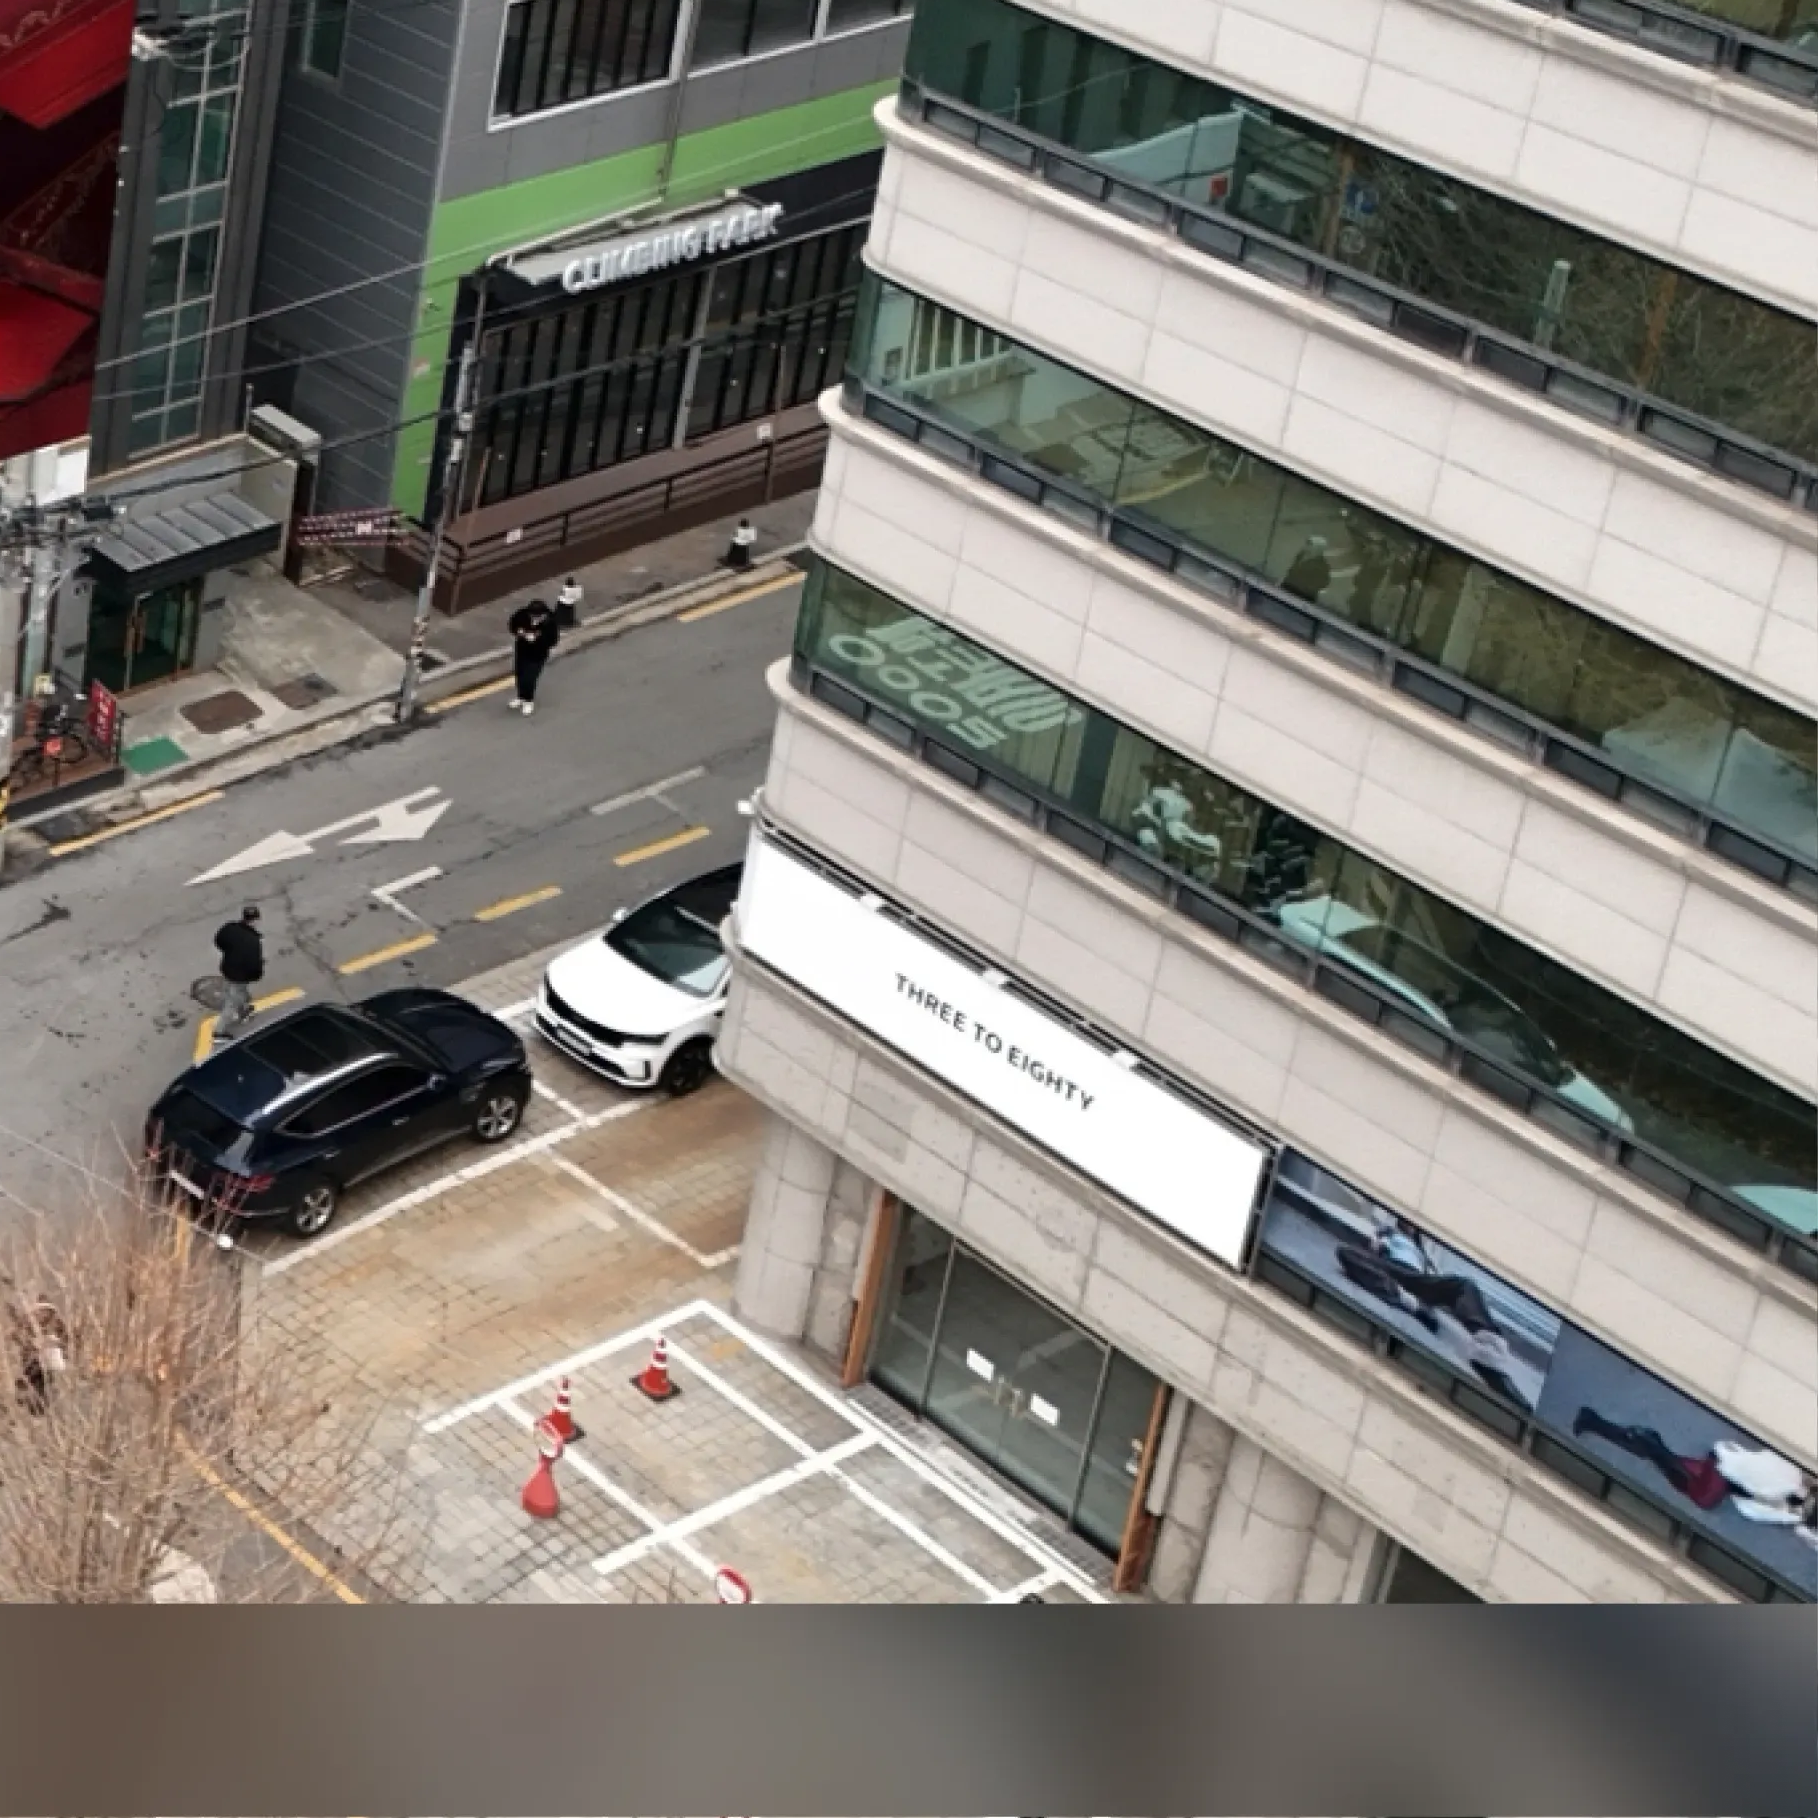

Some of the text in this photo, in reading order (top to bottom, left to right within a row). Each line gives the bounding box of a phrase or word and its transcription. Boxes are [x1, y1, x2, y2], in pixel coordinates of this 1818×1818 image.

[562, 202, 784, 294] CLIMBING PARK
[894, 972, 1096, 1112] THREE TO EIGHTY
